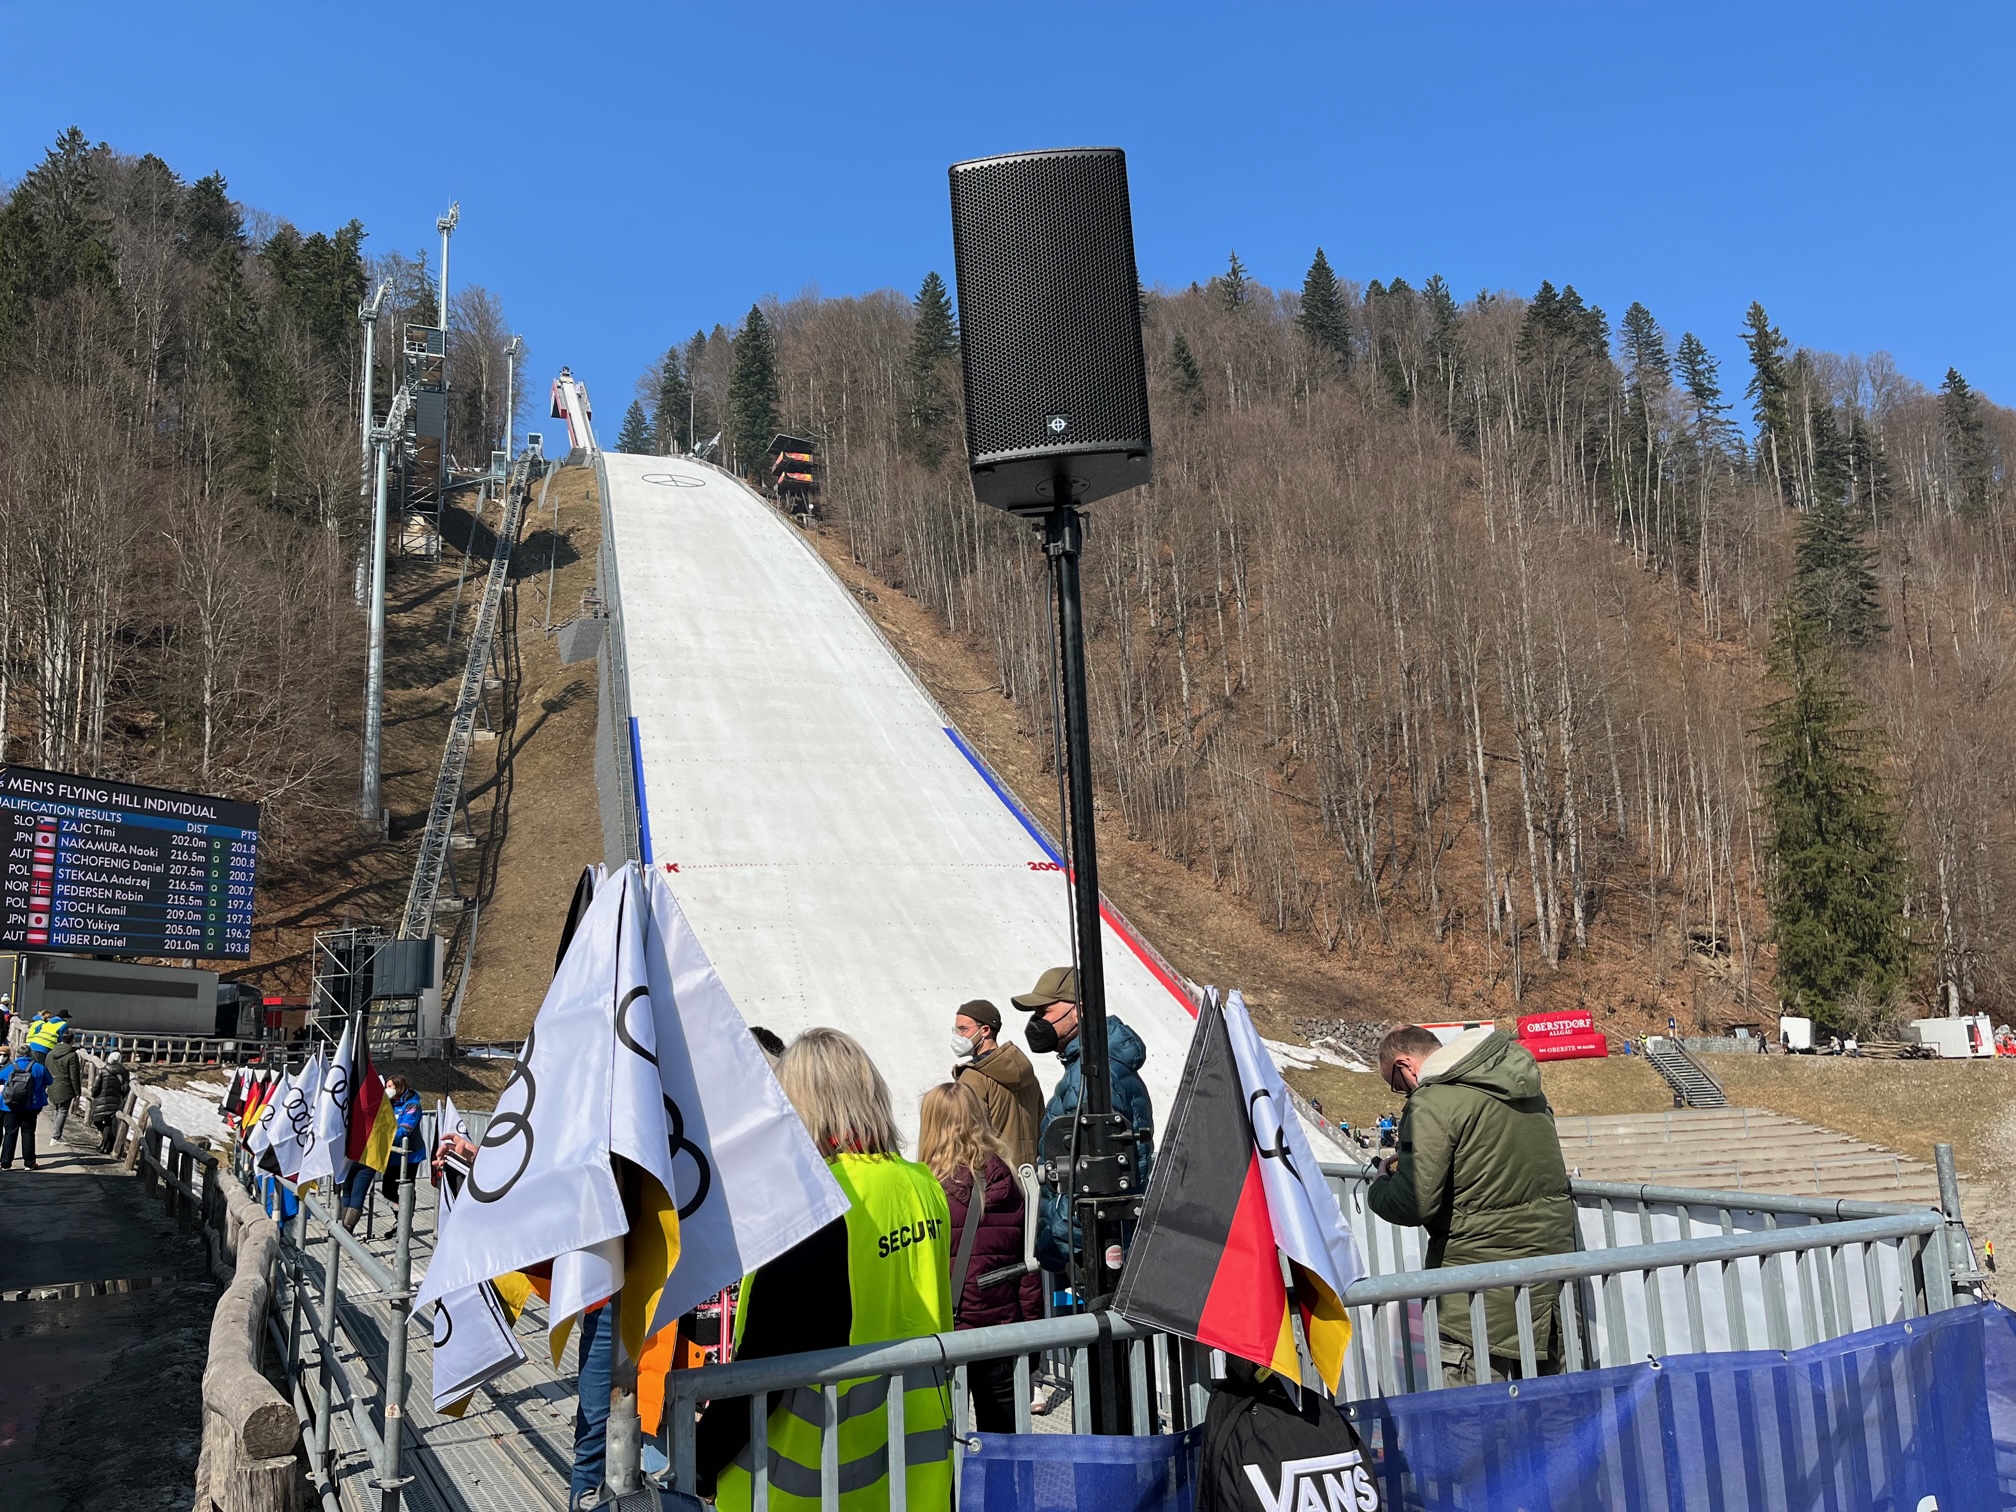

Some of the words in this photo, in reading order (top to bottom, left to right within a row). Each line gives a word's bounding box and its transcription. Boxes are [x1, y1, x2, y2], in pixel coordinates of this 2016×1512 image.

[8, 777, 54, 796] MEN'S
[59, 784, 108, 803] FLYING
[112, 792, 141, 808] HILL
[144, 797, 217, 819] INDIVIDUAL
[14, 815, 34, 827] SLO
[62, 820, 92, 834] ZAJC
[94, 825, 116, 837] Timi
[171, 835, 207, 848] 202.0m
[214, 841, 221, 849] Q
[231, 842, 256, 854] 201.8
[78, 808, 122, 823] RESULTS
[187, 823, 208, 834] DIST
[241, 830, 257, 841] PTS
[9, 848, 32, 859] AUT
[60, 852, 130, 870] TSCHOFENIG
[133, 860, 164, 873] Daniel
[169, 864, 204, 877] 207.5m
[212, 870, 218, 878] Q
[229, 871, 254, 882] 200.7
[14, 831, 33, 843] JPN
[60, 837, 127, 854] NAKAMURA
[130, 845, 158, 858] Naoki
[170, 850, 205, 863] 216.5m
[213, 855, 220, 863] Q
[230, 857, 255, 868] 200.8
[8, 864, 30, 876] POL
[58, 868, 111, 884] STEKALA
[110, 875, 150, 890] Andrzej
[168, 879, 203, 892] 216.5m
[211, 884, 217, 892] Q
[228, 885, 253, 896] 200.7
[666, 863, 680, 873] K
[1027, 861, 1060, 871] 200
[4, 880, 29, 892] NOR
[57, 884, 112, 899] PEDERSEN
[115, 889, 143, 902] Robin
[167, 894, 202, 907] 215.5m
[210, 899, 216, 907] Q
[227, 900, 252, 911] 197.6
[5, 896, 27, 909] POL
[55, 900, 94, 914] STOCH
[97, 903, 126, 916] Kamil
[166, 909, 201, 921] 209.0m
[209, 913, 215, 921] Q
[226, 914, 251, 925] 197.3
[7, 913, 26, 925] JPN
[54, 916, 84, 929] SATO
[86, 920, 120, 933] Yukiya
[165, 924, 200, 936] 205.0m
[208, 928, 215, 936] Q
[225, 928, 250, 939] 196.2
[2, 931, 25, 941] AUT
[53, 932, 90, 945] HUBER
[92, 934, 126, 948] Daniel
[164, 939, 199, 950] 201.0m
[207, 942, 214, 950] Q
[224, 943, 249, 953] 193.8
[1527, 1018, 1592, 1033] OBERSTDORF
[1547, 1045, 1576, 1053] OBERSTE
[1242, 1449, 1378, 1512] VANS
